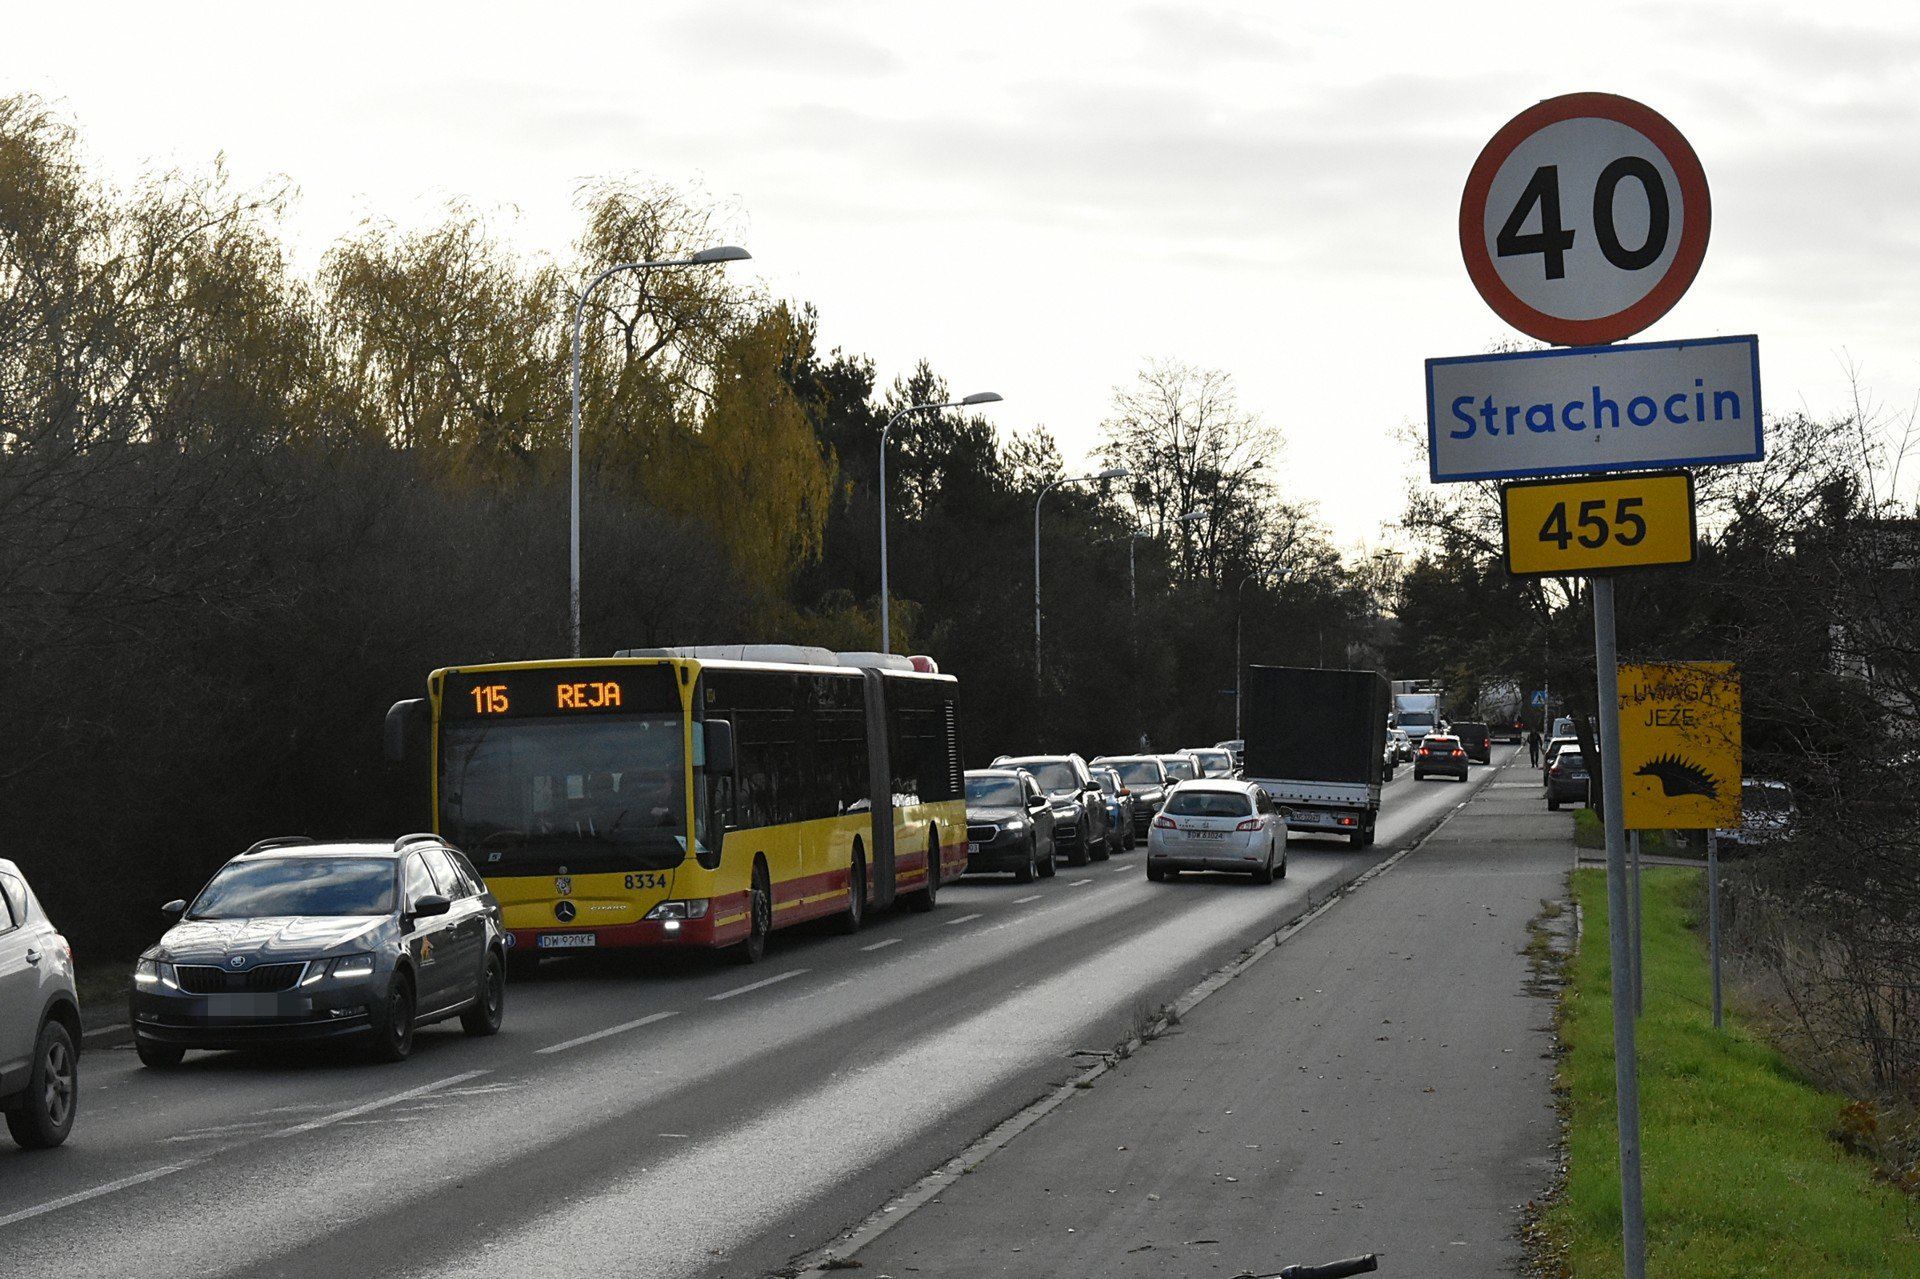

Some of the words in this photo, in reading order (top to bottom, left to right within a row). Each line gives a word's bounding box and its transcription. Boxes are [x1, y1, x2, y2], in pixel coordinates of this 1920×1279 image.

[1496, 155, 1670, 280] 40
[1449, 377, 1742, 441] Strachocin
[1538, 497, 1648, 550] 455
[471, 684, 510, 714] 115
[556, 681, 621, 709] REJA
[1633, 683, 1713, 702] UWAGA
[624, 873, 666, 890] 8334
